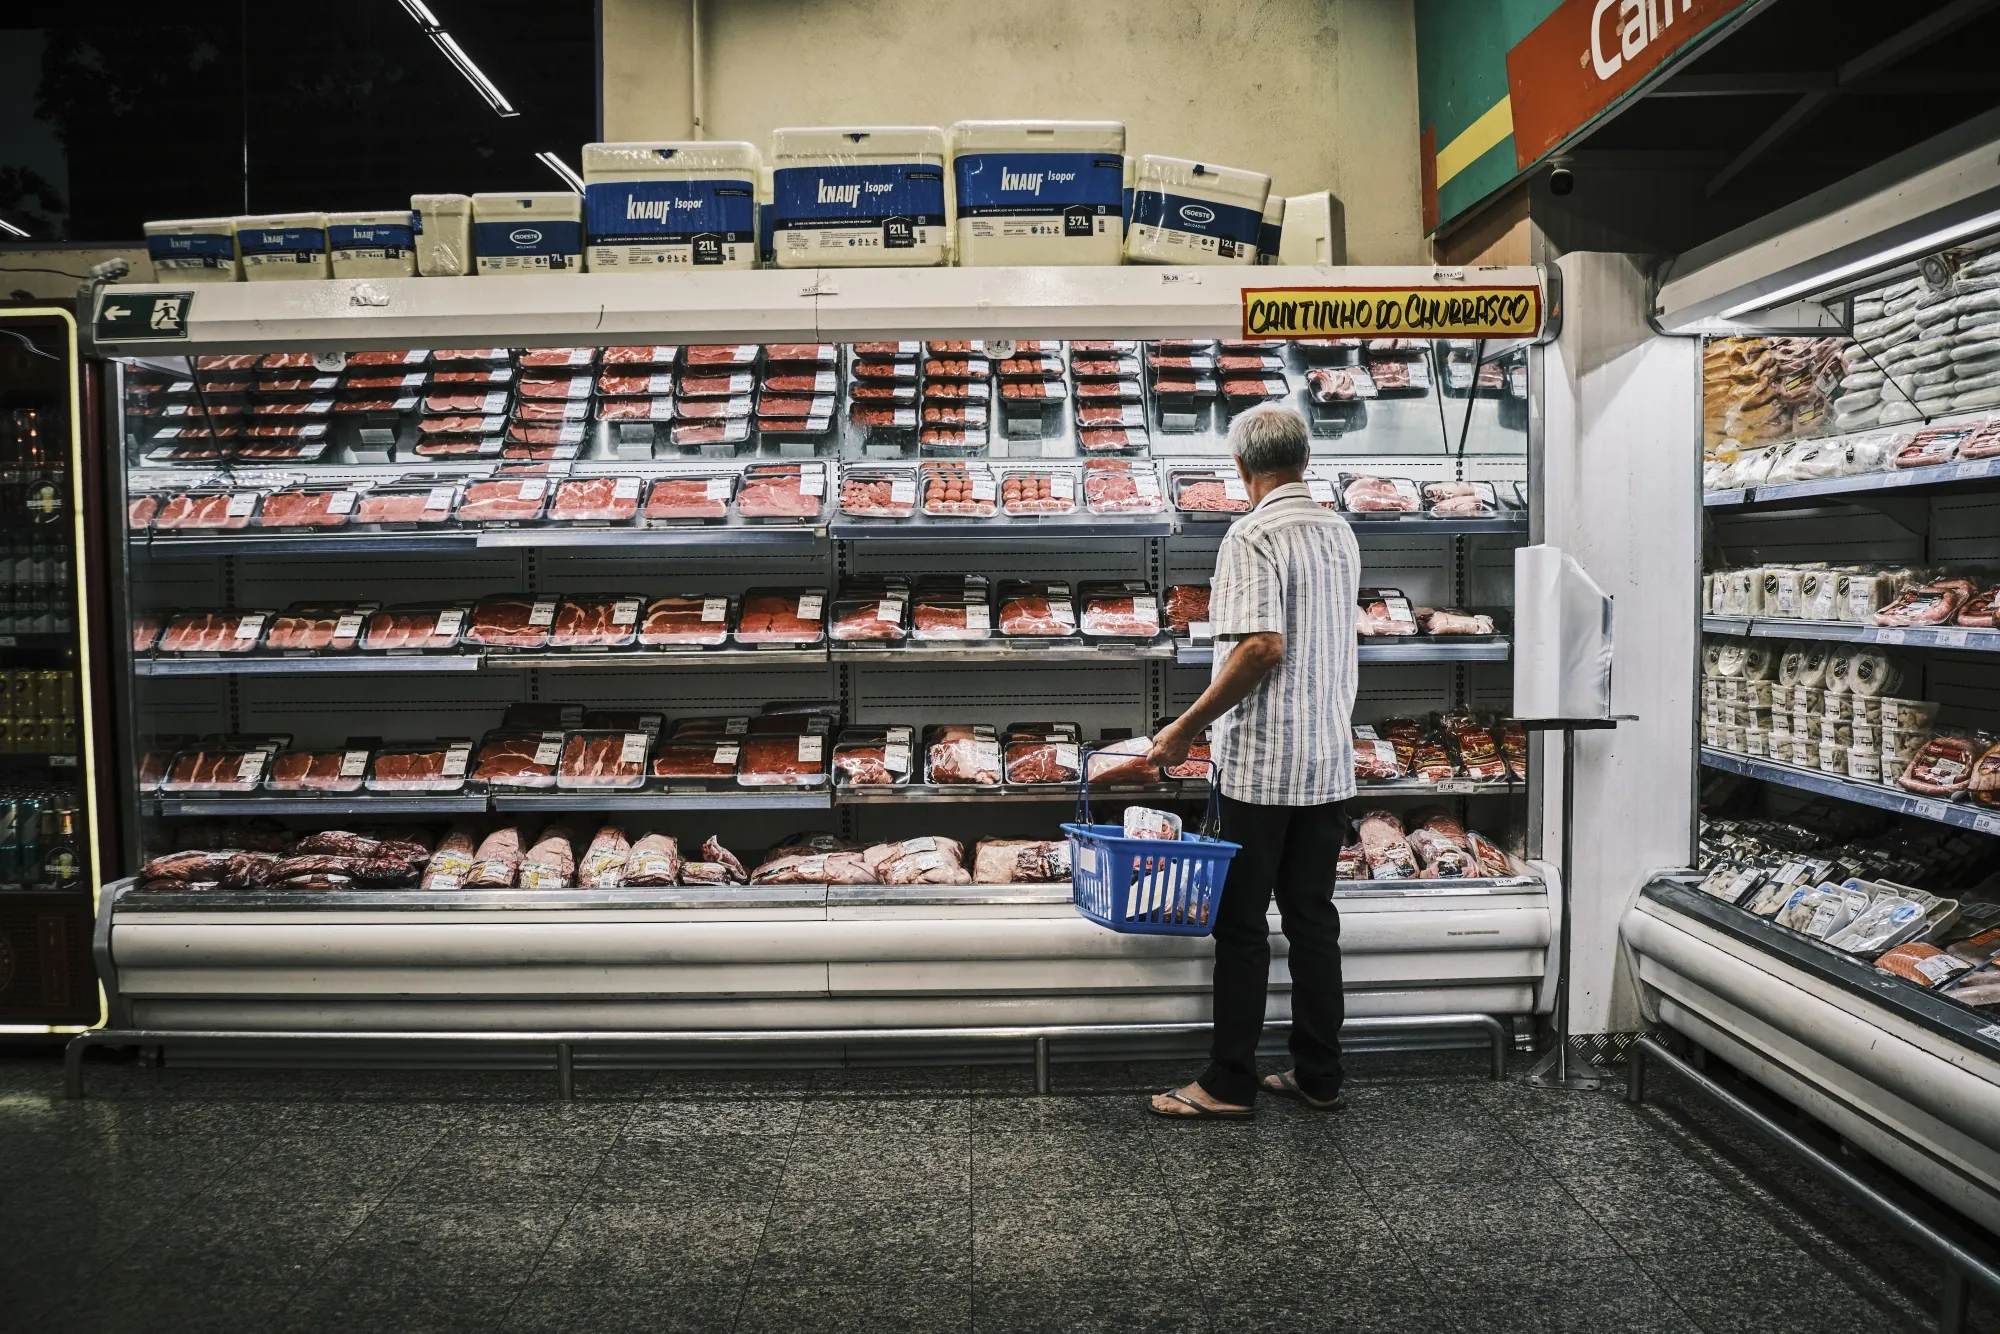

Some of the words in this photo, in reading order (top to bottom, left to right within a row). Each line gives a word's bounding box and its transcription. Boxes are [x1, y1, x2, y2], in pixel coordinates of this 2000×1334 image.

[1001, 166, 1043, 196] KNAUF
[1048, 170, 1075, 184] Isopor
[817, 178, 861, 208] KNAUF
[865, 181, 893, 195] Isopor
[626, 194, 671, 224] KNAUF
[674, 197, 703, 211] Isopor
[1184, 209, 1210, 219] ISOESTE
[1068, 216, 1089, 226] 37L
[353, 228, 374, 241] KNAUF
[890, 224, 908, 234] 21L
[262, 232, 284, 245] KNAUF
[1221, 239, 1234, 248] 12L
[699, 240, 718, 250] 21L
[552, 254, 563, 262] 7L
[1249, 298, 1372, 334] CANTINHO
[1375, 299, 1402, 330] DO
[1404, 293, 1529, 331] CHURRASCO
